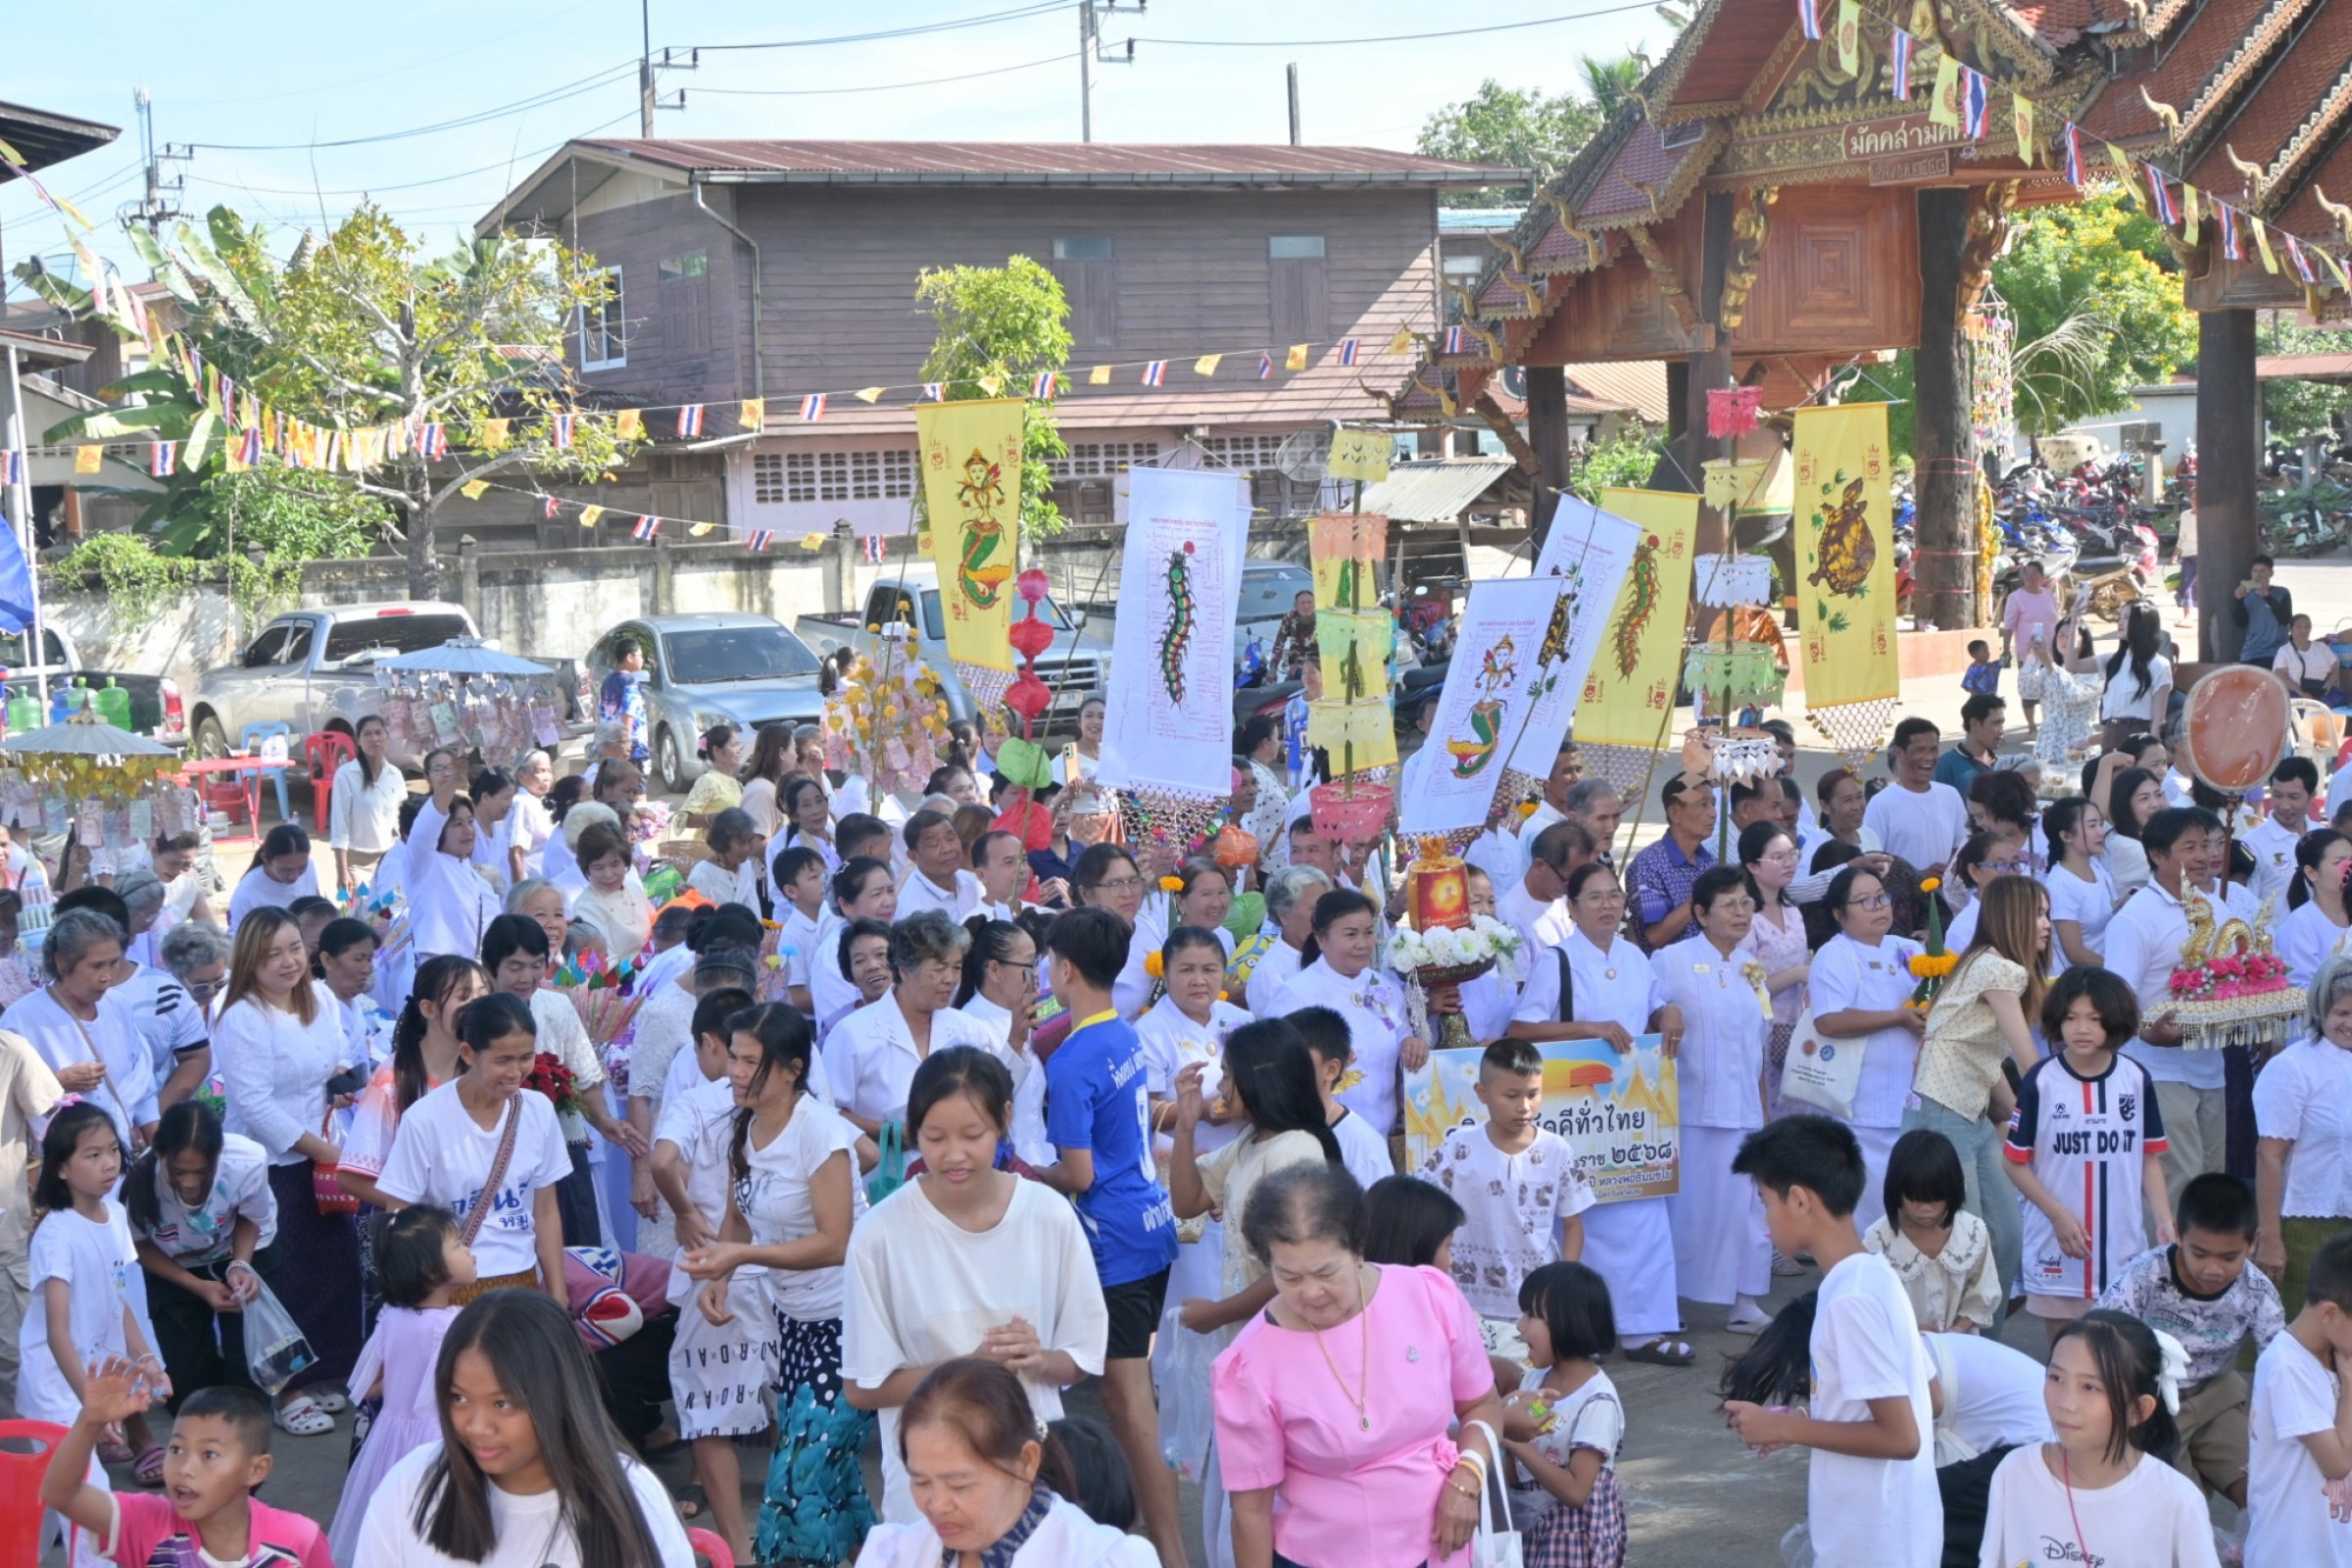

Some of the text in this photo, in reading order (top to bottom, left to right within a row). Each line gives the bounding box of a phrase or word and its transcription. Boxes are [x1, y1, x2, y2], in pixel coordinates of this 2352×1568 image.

[1611, 1140, 1673, 1164] ๒๕๖๘
[2052, 1129, 2136, 1154] JUST DO IT
[2039, 1535, 2105, 1568] Disney
